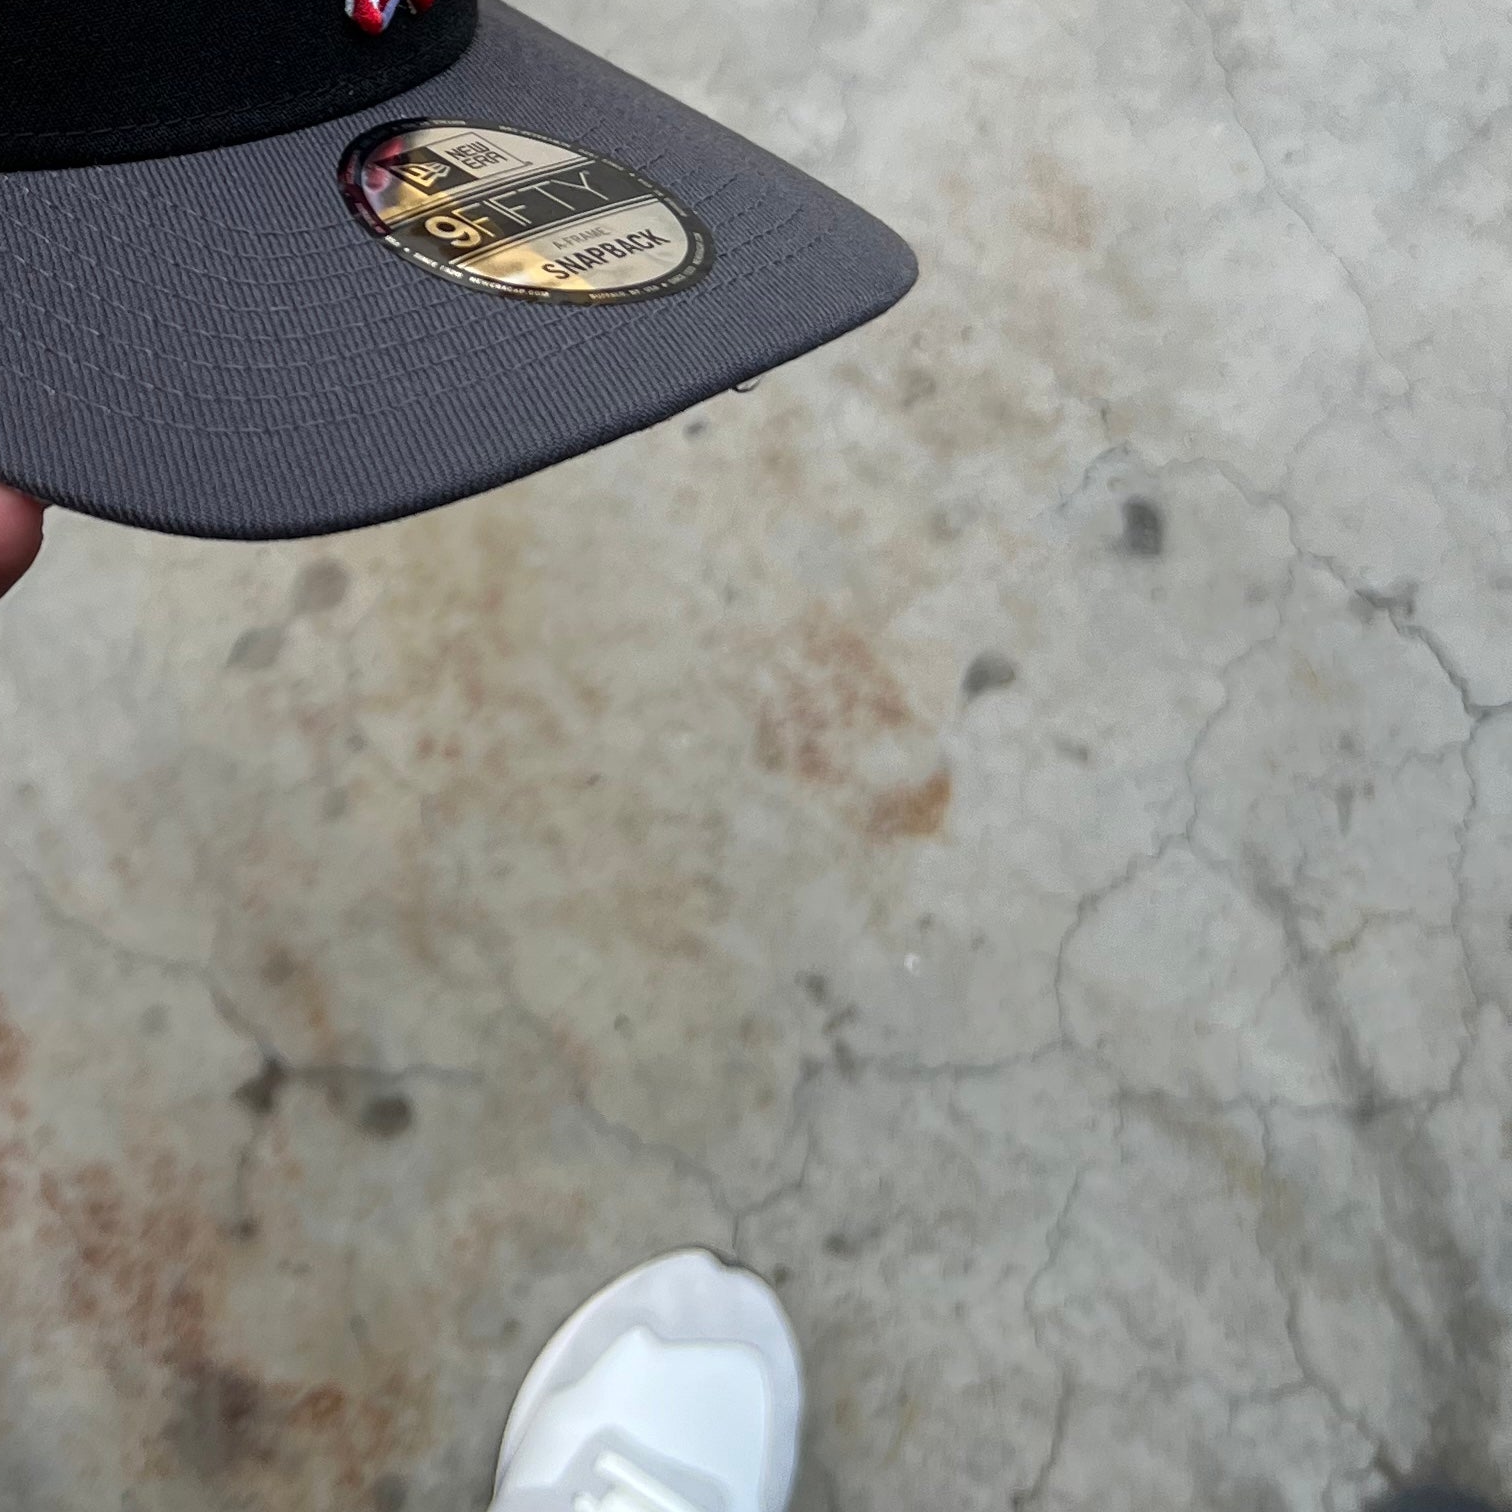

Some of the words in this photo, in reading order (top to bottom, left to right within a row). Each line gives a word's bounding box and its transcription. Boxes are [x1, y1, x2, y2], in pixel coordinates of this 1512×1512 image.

[445, 141, 490, 160] NEW
[462, 152, 508, 170] ERA
[424, 170, 609, 248] 9FIFTY
[541, 228, 672, 280] SNAPBACK
